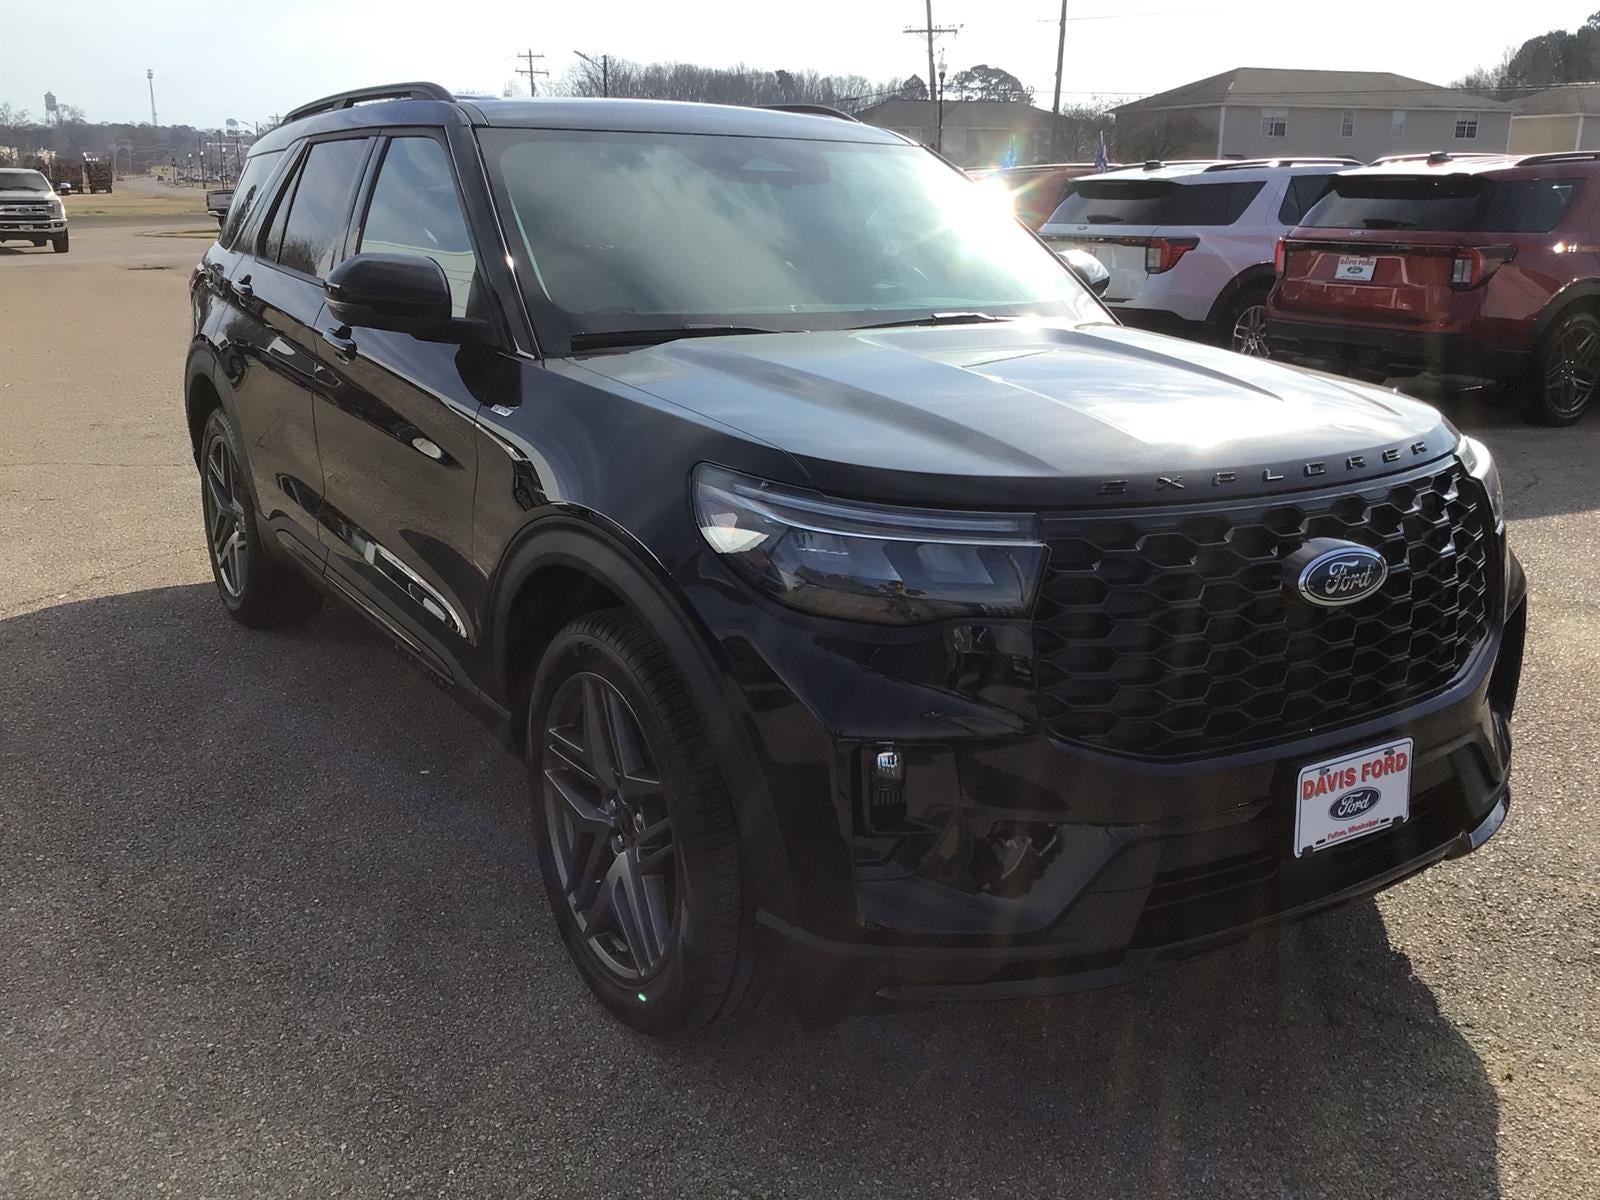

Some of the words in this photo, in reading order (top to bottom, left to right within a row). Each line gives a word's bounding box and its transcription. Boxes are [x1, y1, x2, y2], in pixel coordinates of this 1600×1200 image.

[1099, 440, 1427, 495] EXPLORER
[1325, 560, 1372, 594] Ford
[1302, 767, 1356, 800] DAVIS
[1361, 753, 1407, 782] FORD
[1338, 792, 1371, 816] Ford
